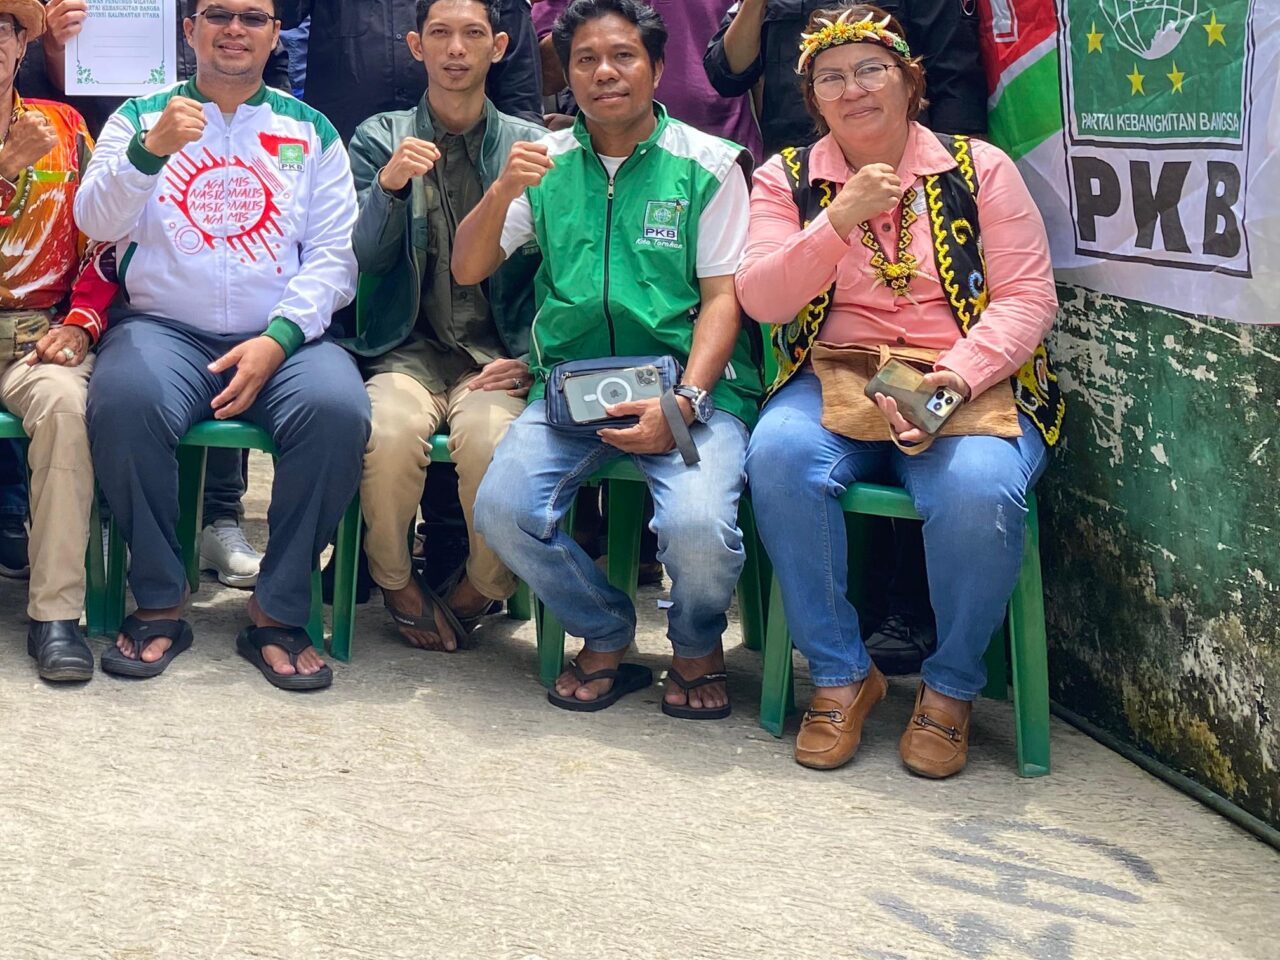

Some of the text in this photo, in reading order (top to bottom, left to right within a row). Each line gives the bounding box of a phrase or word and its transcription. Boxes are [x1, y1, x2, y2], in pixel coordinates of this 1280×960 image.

[1081, 112, 1239, 132] PARTAI KEBANGKITAN BANGSA
[281, 163, 303, 171] PKB
[1071, 156, 1242, 258] PKB
[645, 228, 676, 238] PKB
